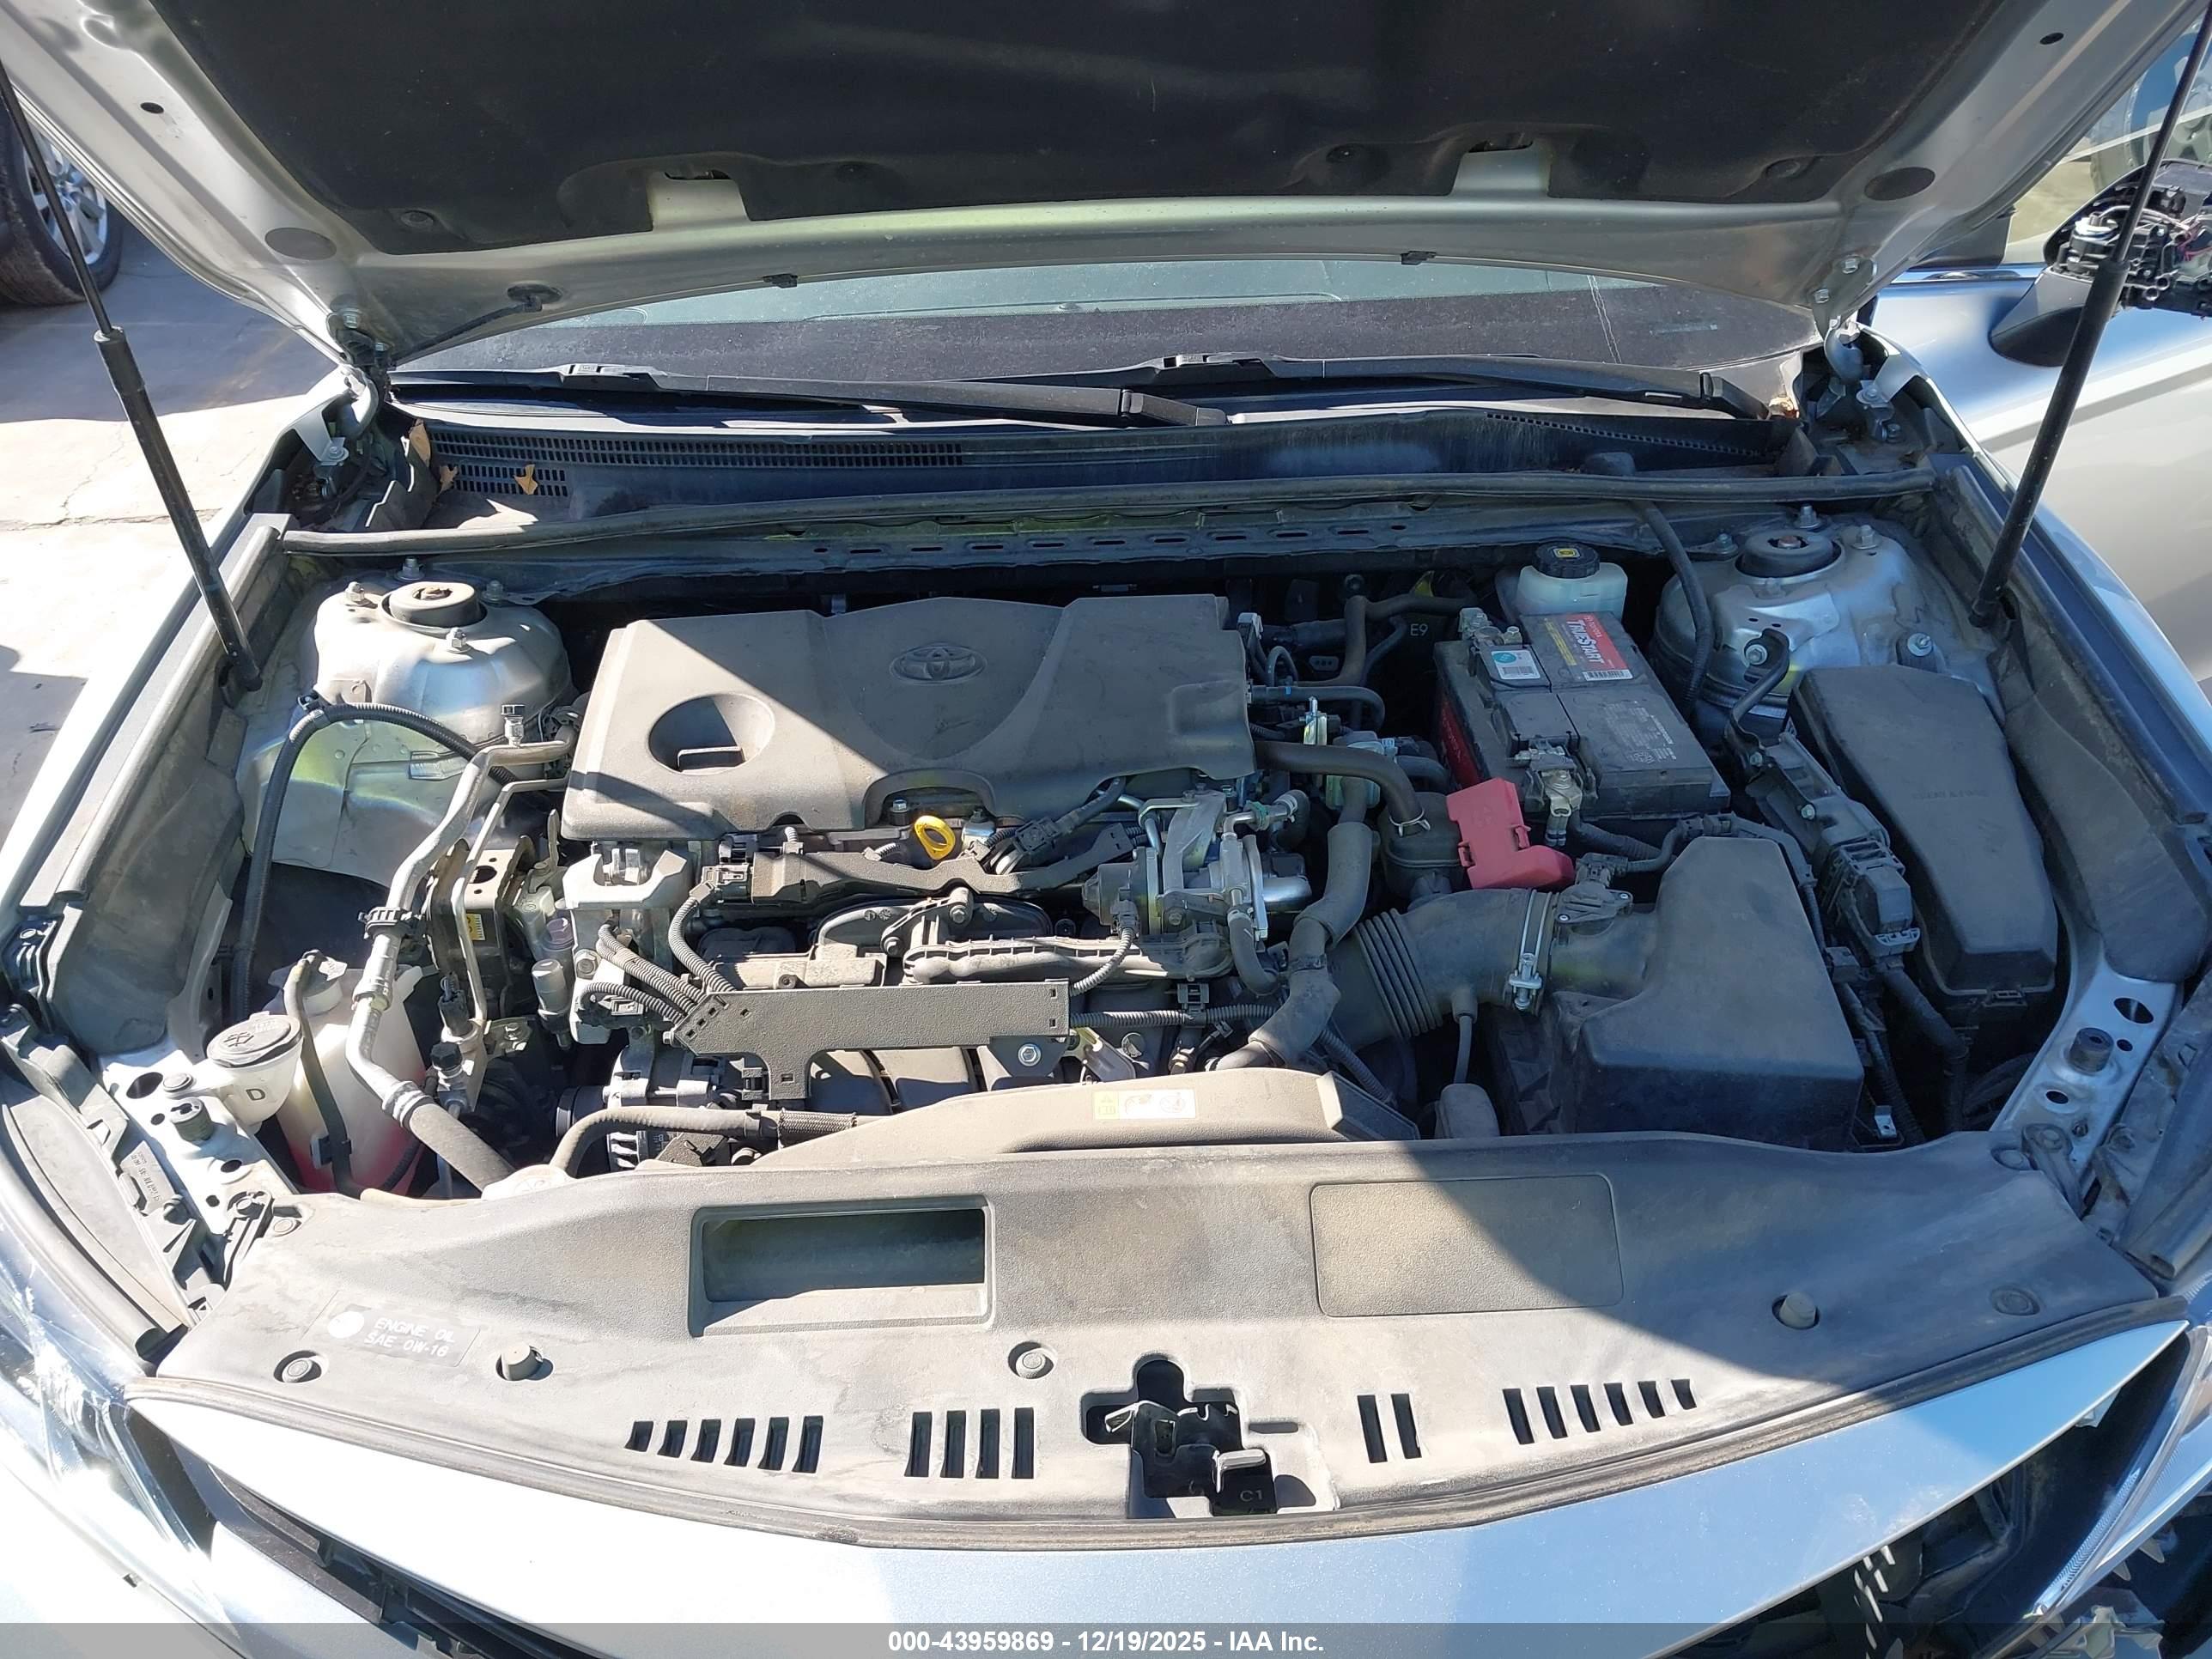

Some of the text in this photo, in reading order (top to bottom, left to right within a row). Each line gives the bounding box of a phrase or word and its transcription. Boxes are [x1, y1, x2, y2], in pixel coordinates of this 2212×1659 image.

[1410, 623, 1429, 636] E9
[246, 1088, 265, 1101] D
[375, 1317, 456, 1343] ENGINE OIL
[363, 1331, 398, 1348] SAE
[1240, 1490, 1262, 1502] C1
